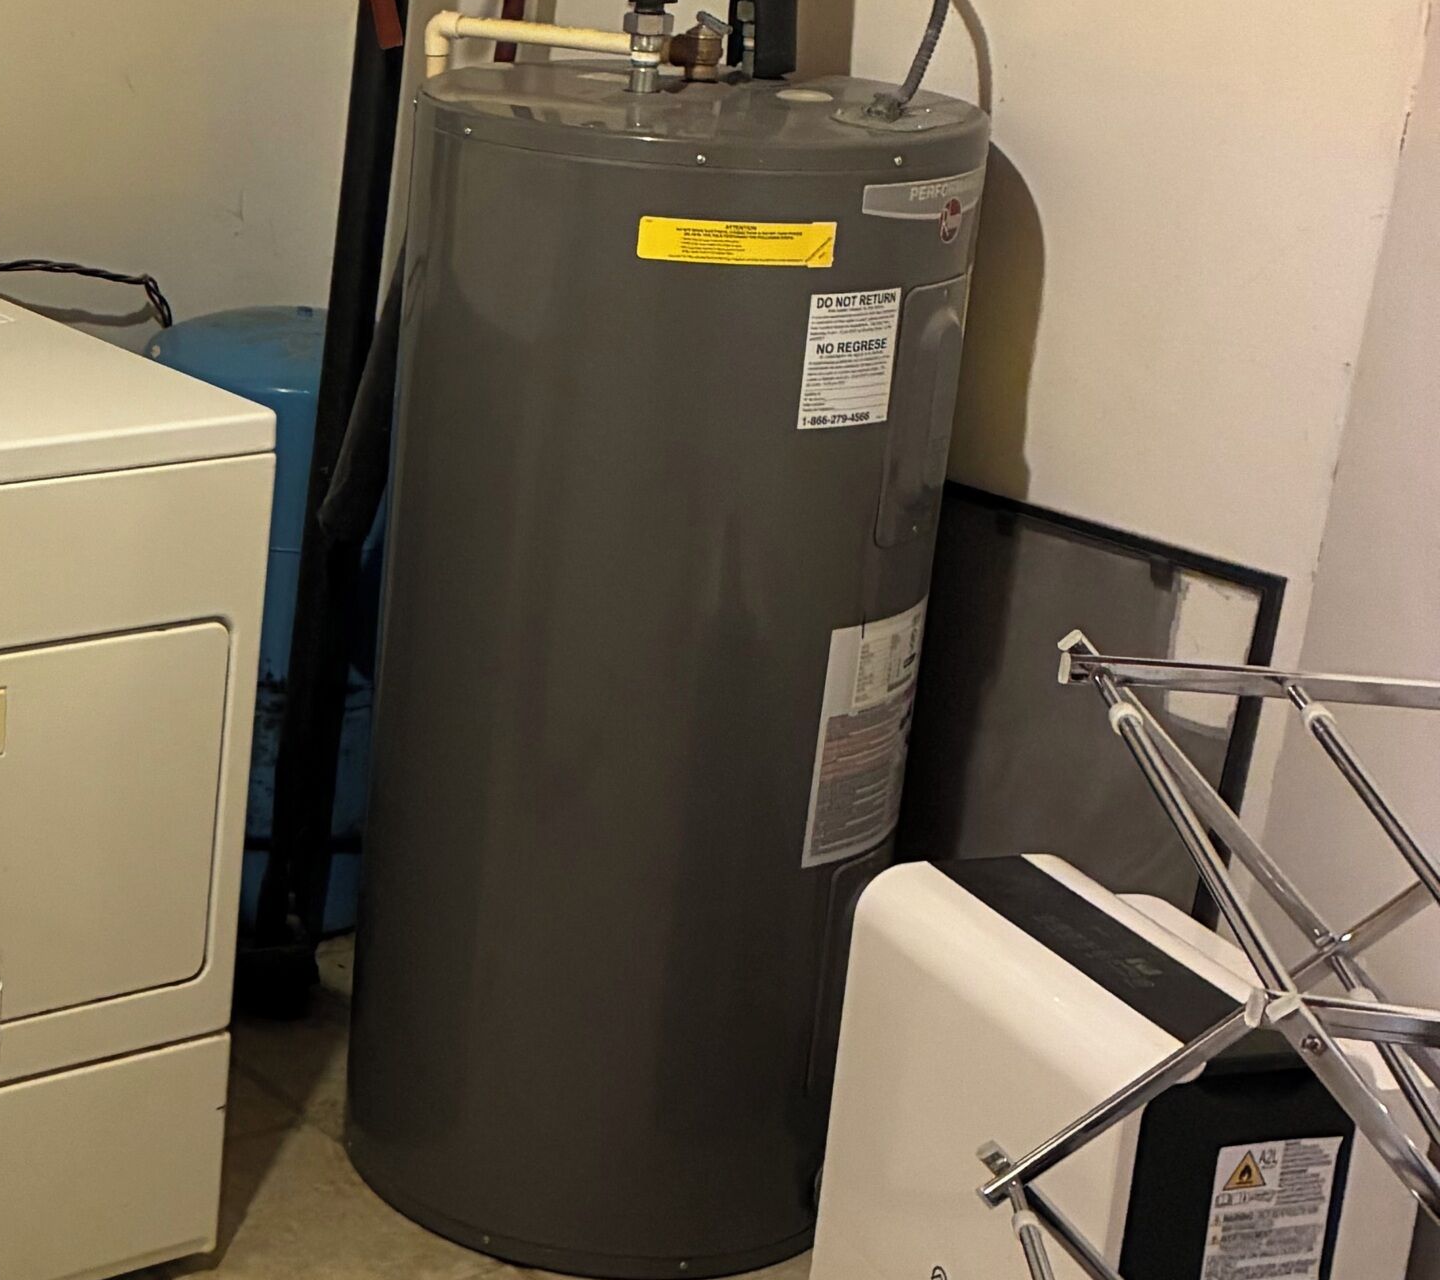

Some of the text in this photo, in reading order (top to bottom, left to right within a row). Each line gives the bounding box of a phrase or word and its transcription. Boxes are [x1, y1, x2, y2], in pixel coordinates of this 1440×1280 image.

[816, 292, 897, 309] DO NOT RETURN
[816, 337, 888, 355] NO REGRESE
[1259, 1147, 1278, 1166] A2L
